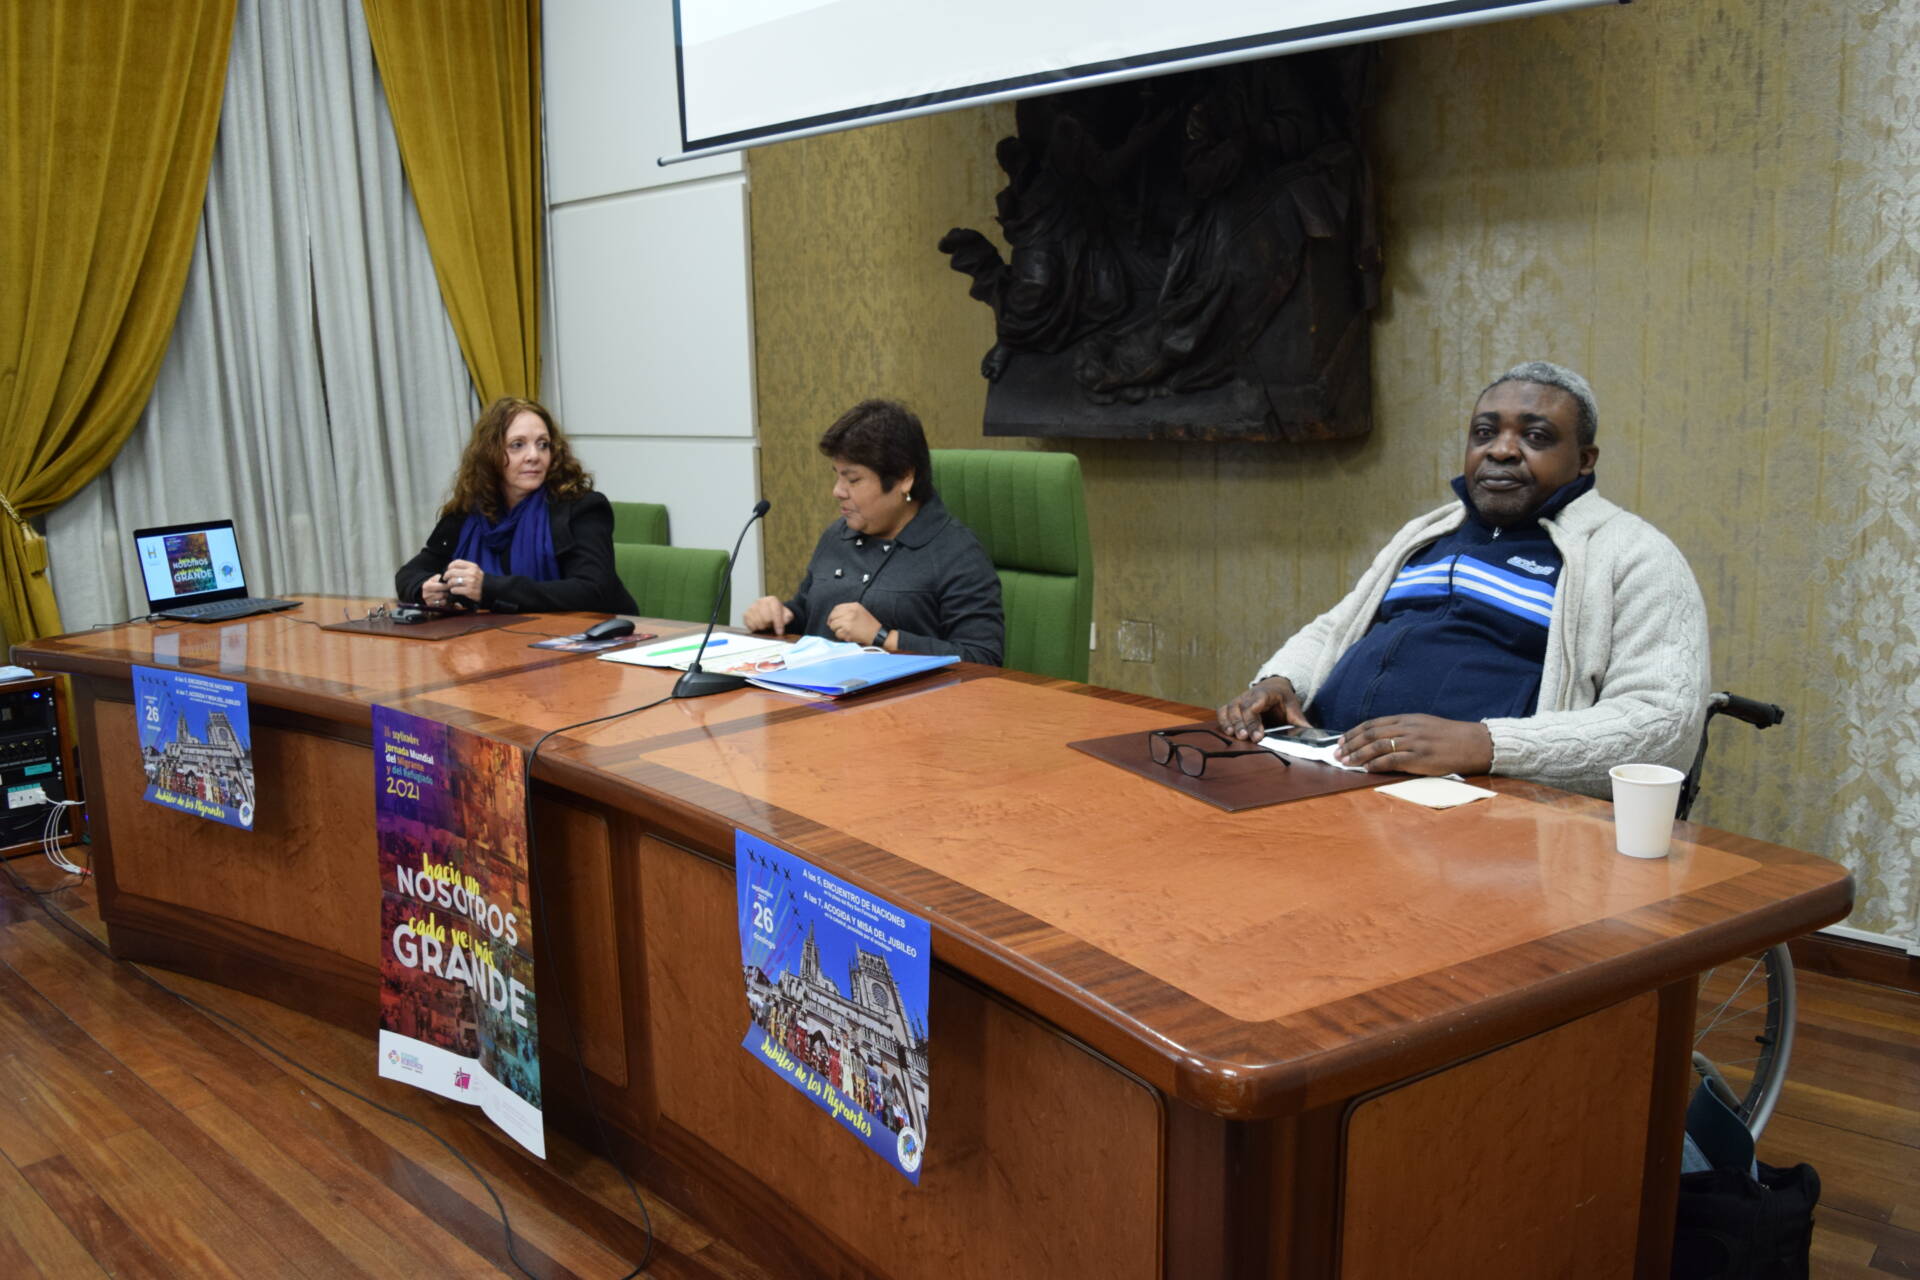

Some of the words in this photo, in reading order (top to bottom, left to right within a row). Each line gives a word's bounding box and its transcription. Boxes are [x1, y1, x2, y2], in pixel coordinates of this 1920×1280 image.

[174, 569, 213, 582] GRANDE
[146, 704, 159, 723] 26
[385, 742, 410, 757] Jornada
[409, 749, 435, 766] Mundial
[385, 753, 397, 764] del
[386, 777, 420, 801] 2021
[422, 852, 462, 885] hacia
[464, 875, 480, 896] un
[396, 864, 518, 946] NOSOTROS
[753, 902, 774, 934] 26
[823, 879, 861, 905] ENCUENTRO
[861, 898, 871, 910] DE
[871, 903, 906, 928] NACIONES
[408, 912, 446, 944] cada
[474, 939, 497, 971] más
[823, 901, 852, 923] ACOGIDA
[856, 919, 873, 935] MISA
[873, 927, 887, 943] DEL
[887, 936, 917, 958] JUBILEO
[392, 924, 529, 1029] GRANDE
[761, 1035, 795, 1072] Jubileo
[795, 1063, 807, 1084] de
[807, 1072, 822, 1096] los
[822, 1082, 872, 1138] Migrantes
